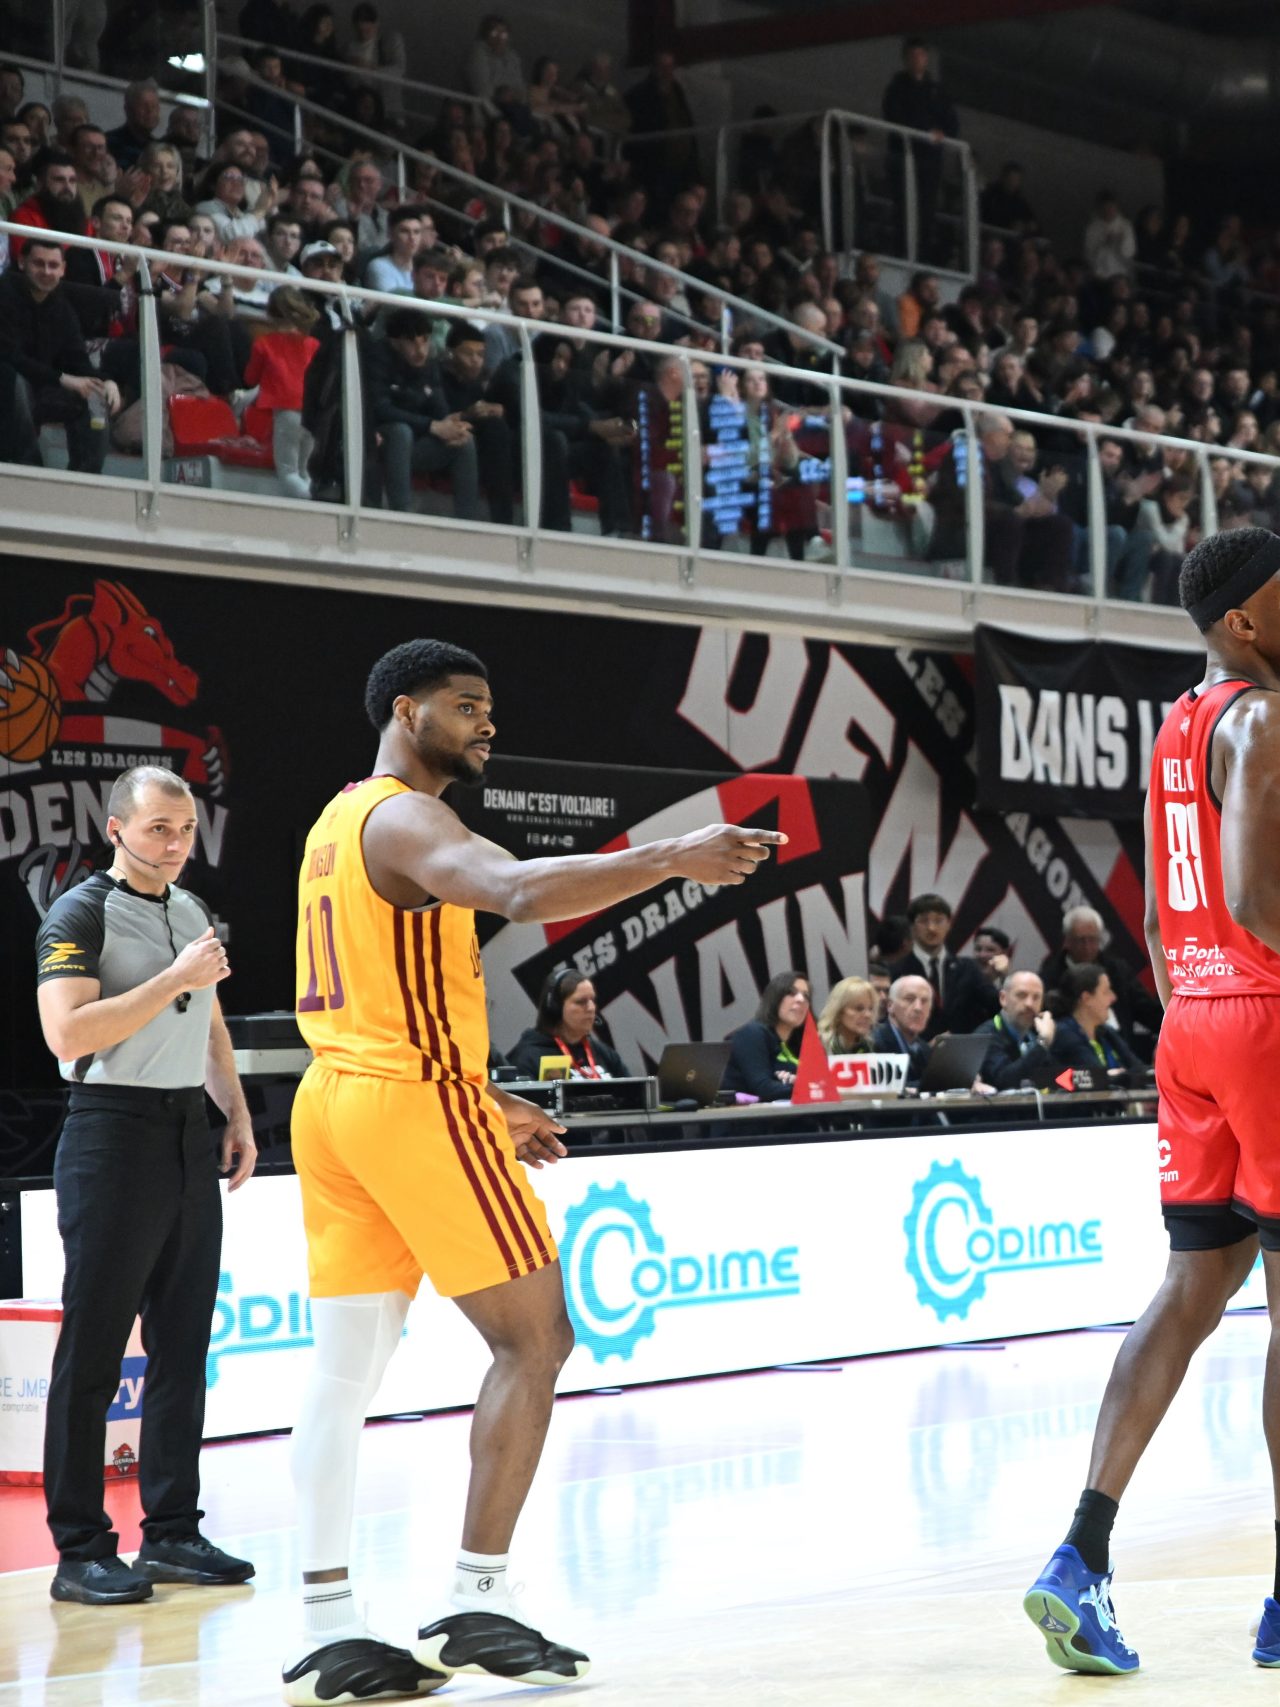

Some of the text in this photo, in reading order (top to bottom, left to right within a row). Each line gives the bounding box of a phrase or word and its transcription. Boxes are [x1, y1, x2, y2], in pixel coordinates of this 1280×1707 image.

[52, 749, 87, 766] LES
[998, 685, 1130, 790] DANS
[484, 788, 525, 811] DENAIN
[528, 792, 557, 814] C'EST
[560, 795, 609, 817] VOLTAIRE
[298, 895, 345, 1013] 10
